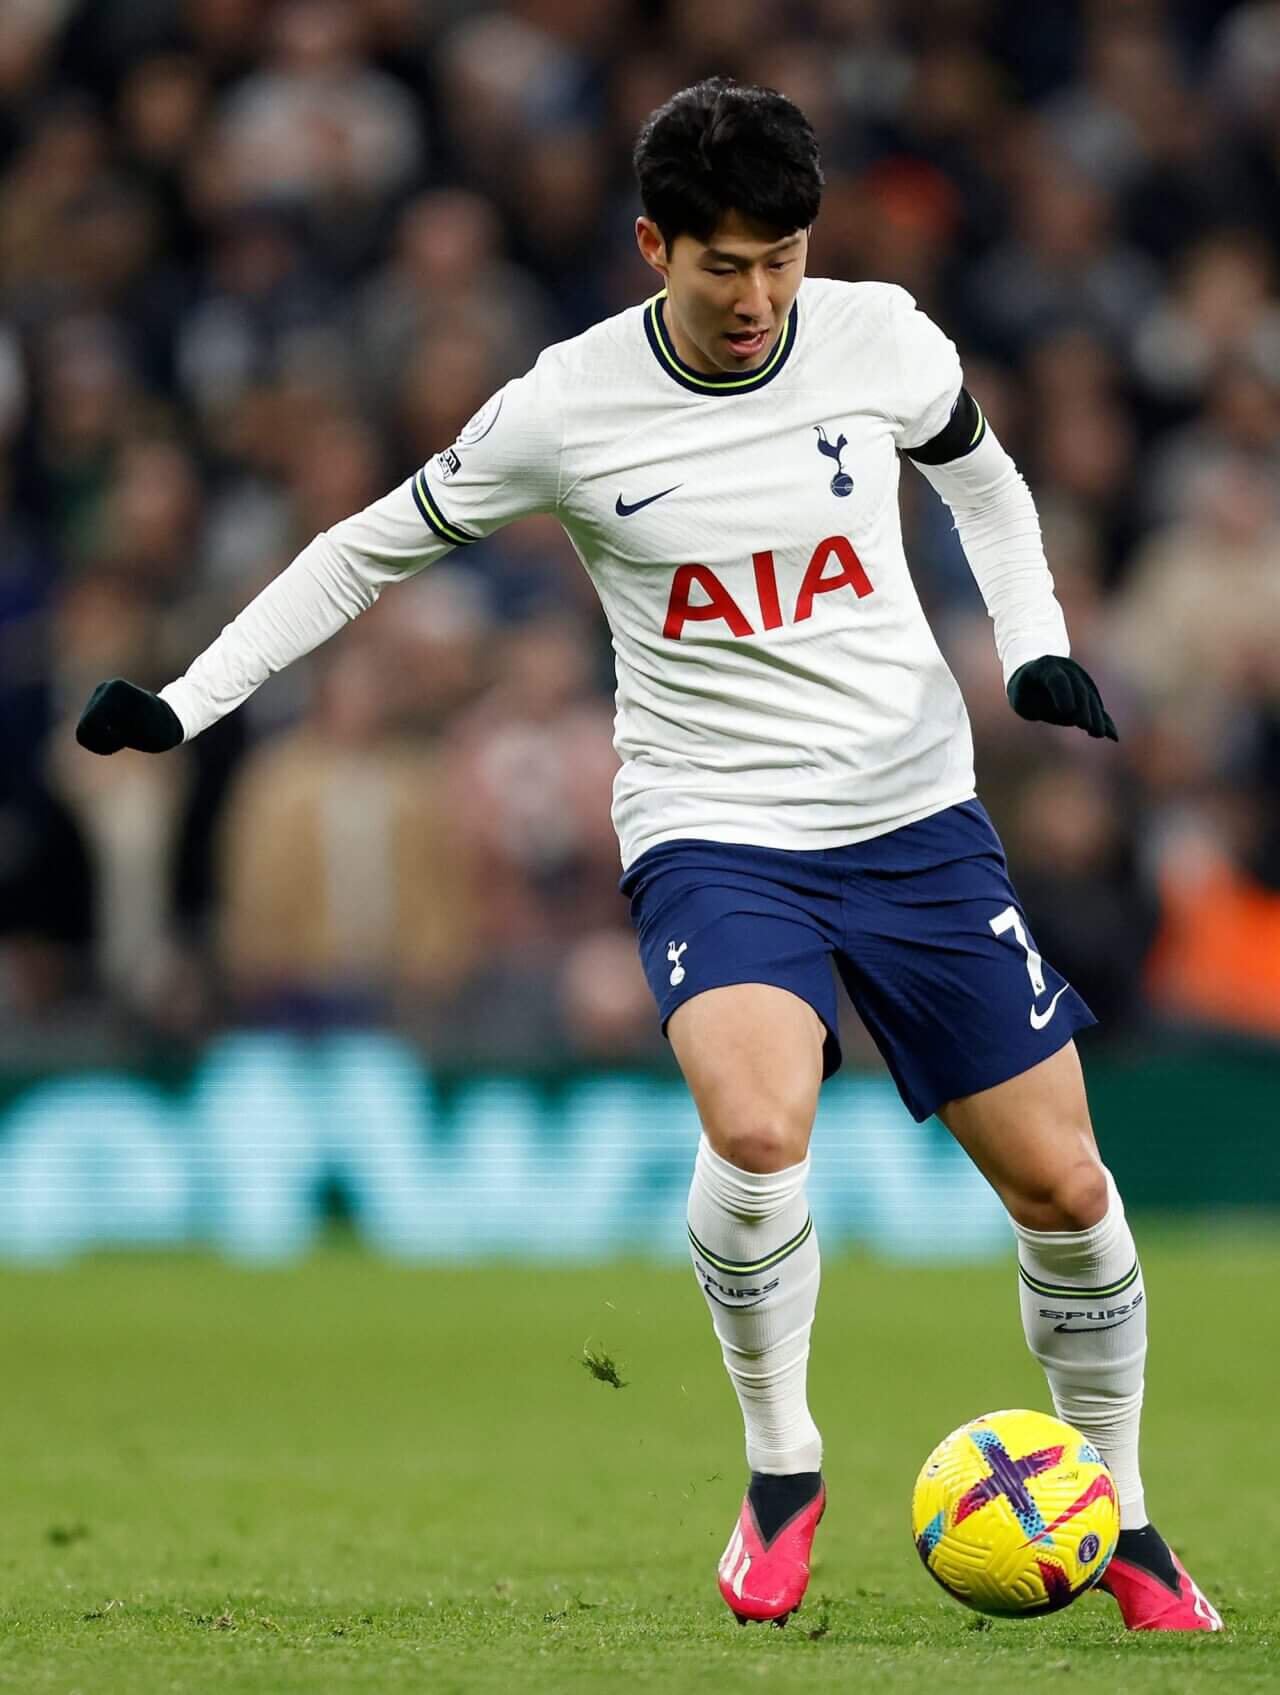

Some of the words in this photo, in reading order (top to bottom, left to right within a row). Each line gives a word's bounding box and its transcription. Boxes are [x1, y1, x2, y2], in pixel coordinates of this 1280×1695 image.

[661, 535, 874, 641] AIA
[988, 905, 1047, 997] 7
[1039, 1290, 1144, 1320] SPURS
